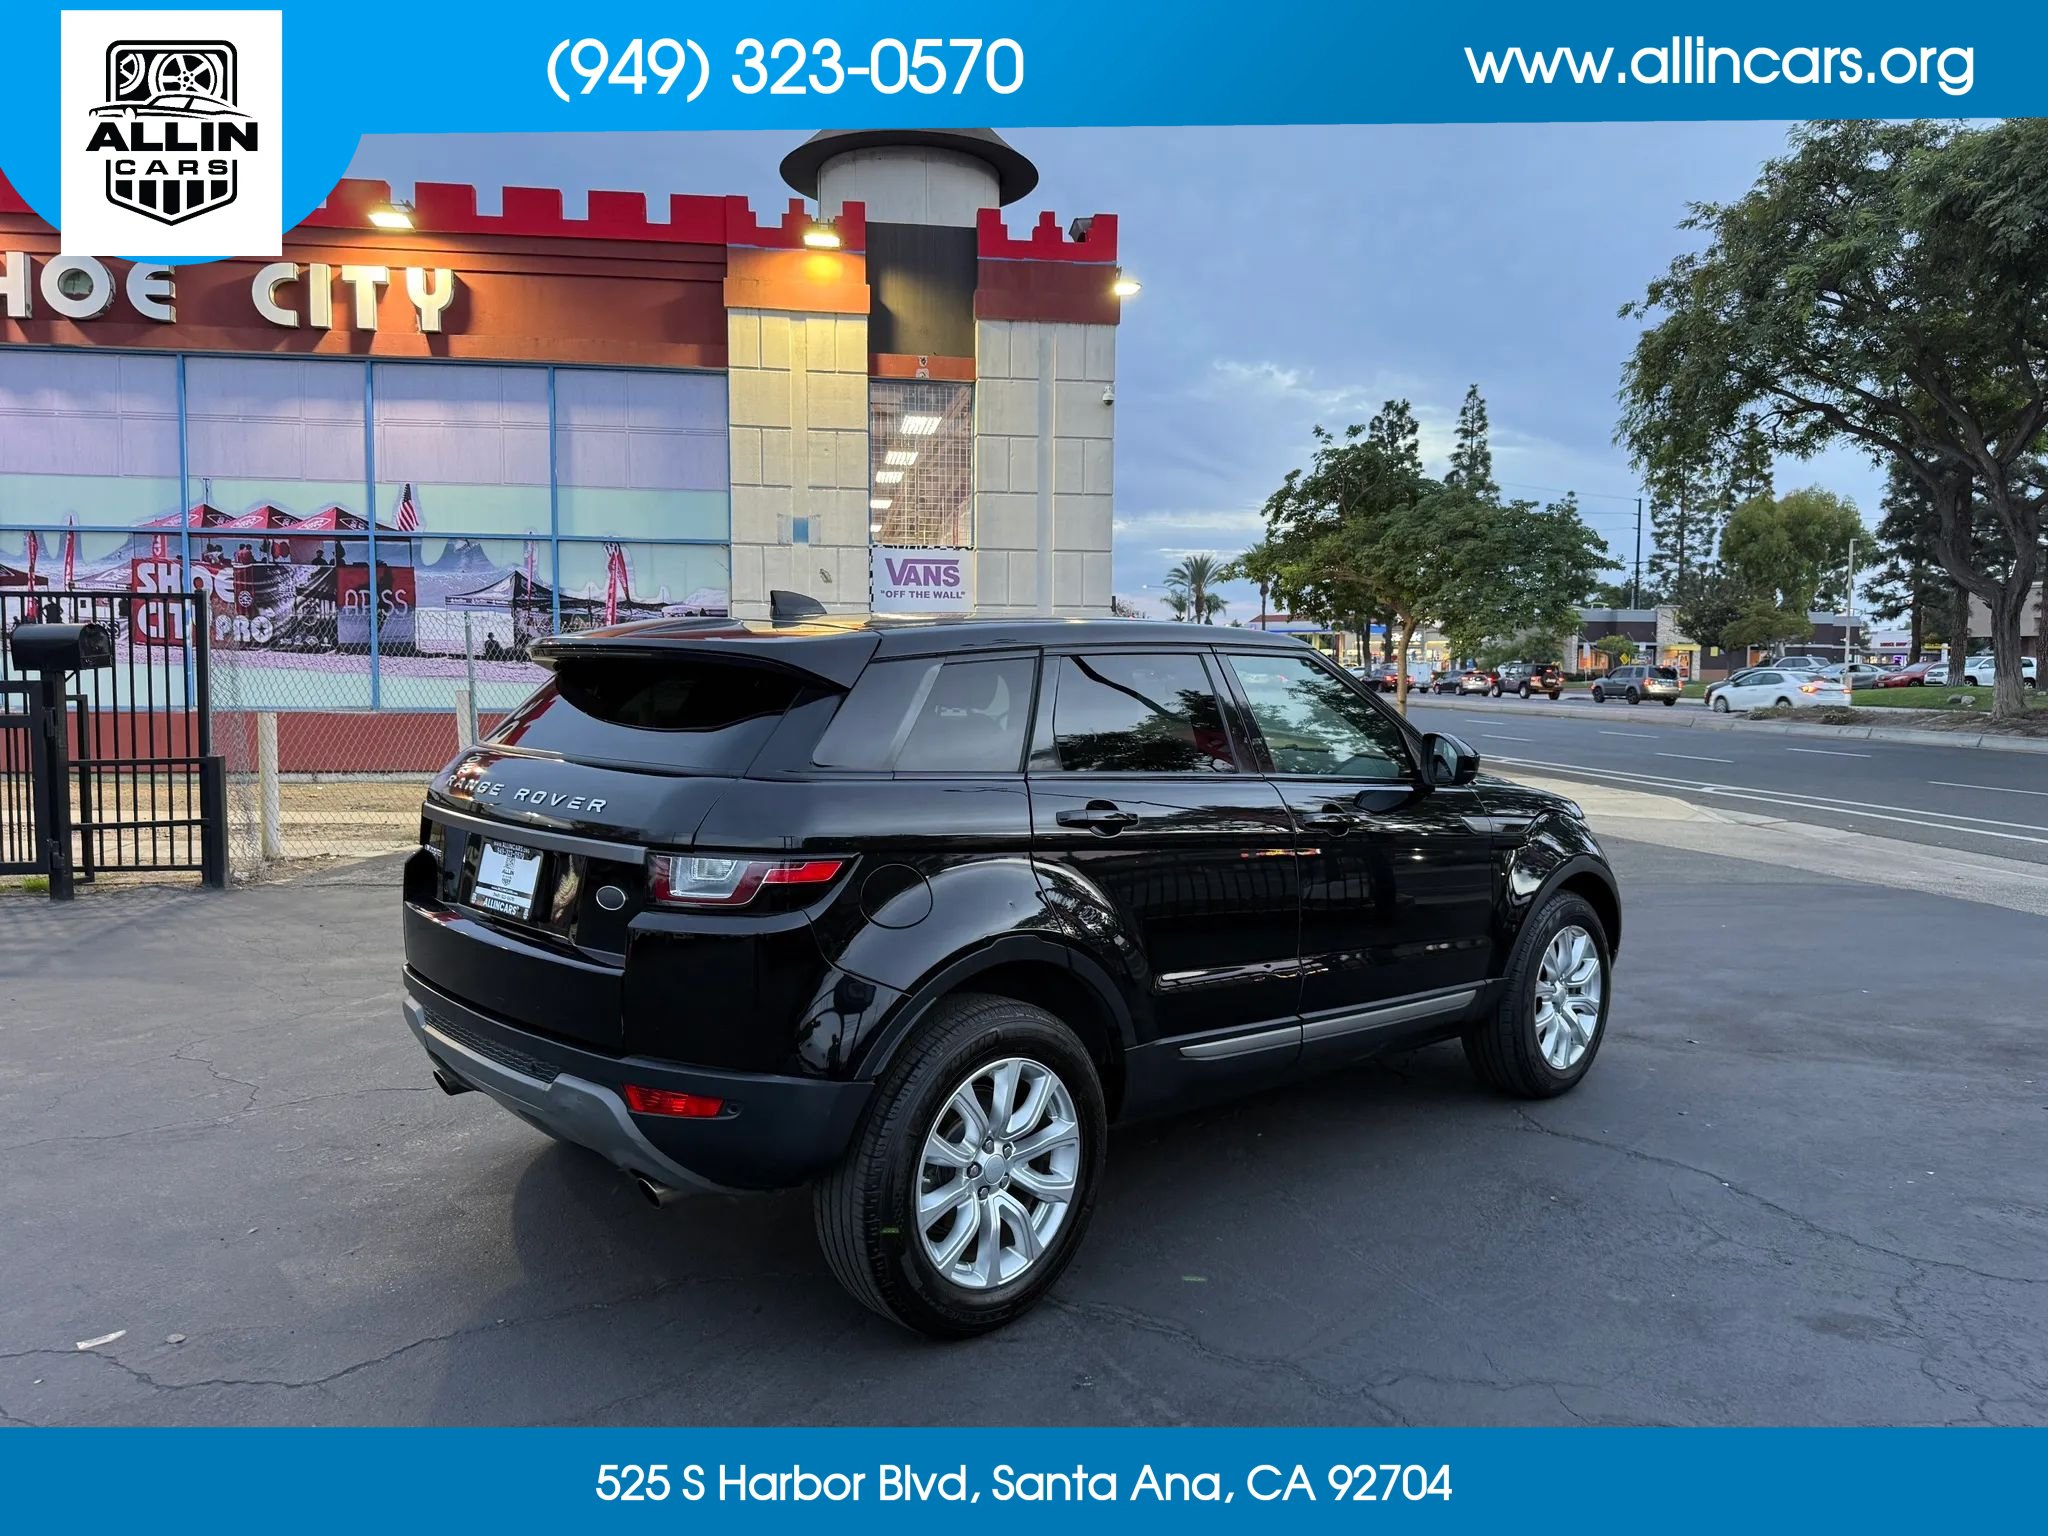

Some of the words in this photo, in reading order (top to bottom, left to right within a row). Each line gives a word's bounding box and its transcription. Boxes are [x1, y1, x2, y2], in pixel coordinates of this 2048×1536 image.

[252, 262, 456, 334] CITY
[137, 562, 235, 603] SHOE
[884, 557, 960, 587] VANS
[880, 590, 906, 599] "OFF
[908, 590, 931, 599] THE
[933, 591, 966, 599] WALL"
[137, 601, 212, 640] CIT
[215, 614, 273, 644] PRO
[445, 774, 505, 796] RANGE
[514, 787, 608, 813] ROVER
